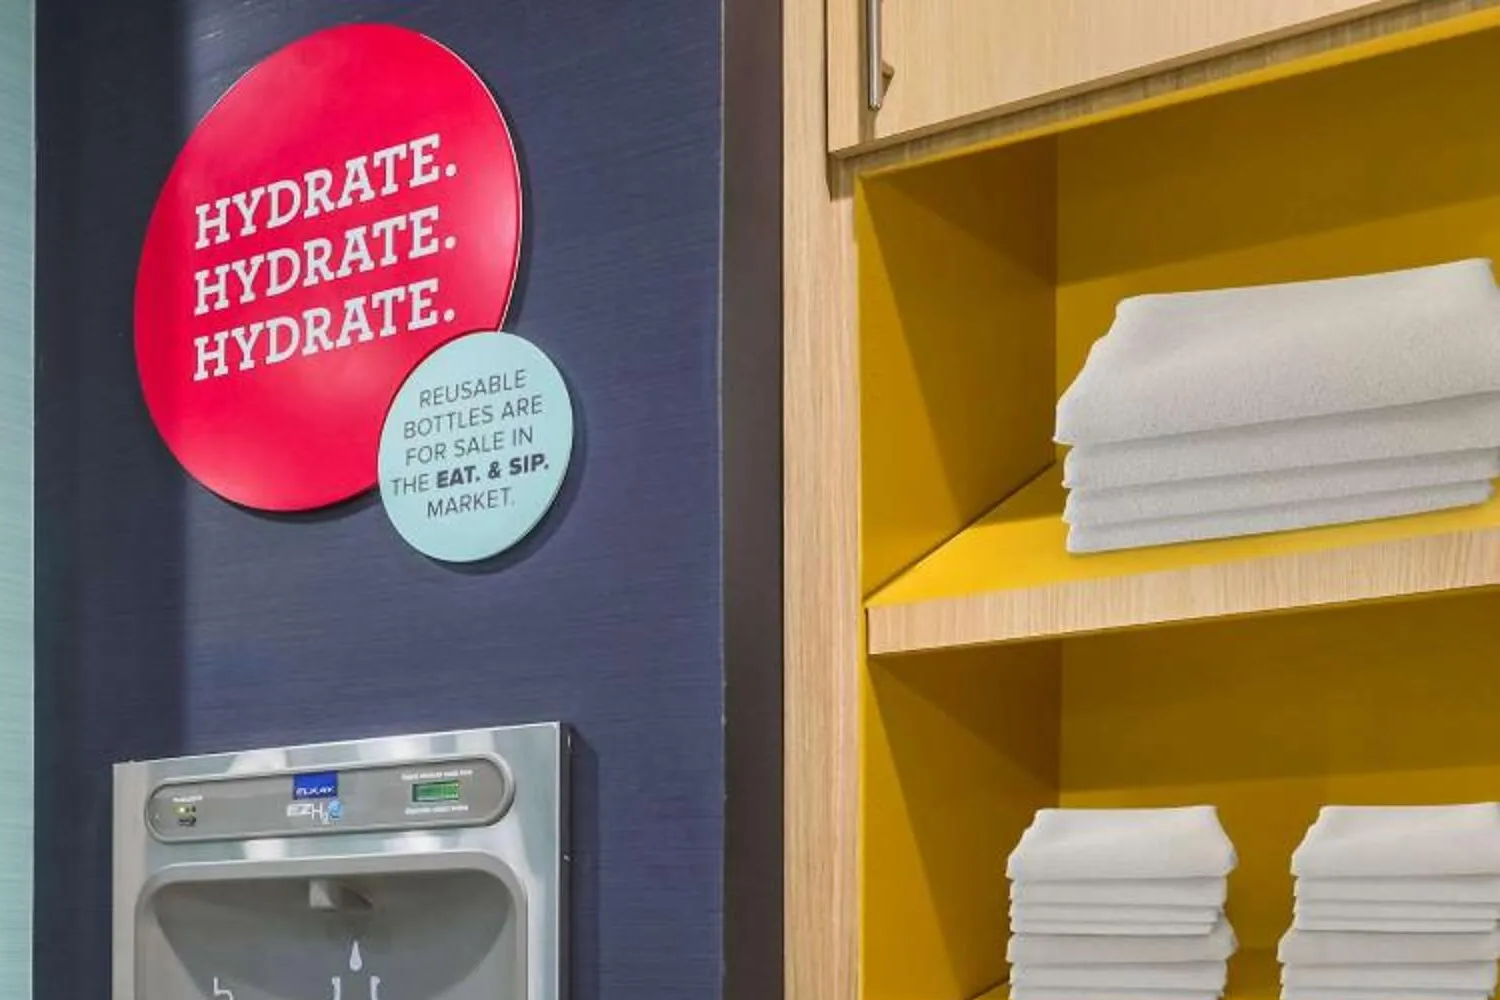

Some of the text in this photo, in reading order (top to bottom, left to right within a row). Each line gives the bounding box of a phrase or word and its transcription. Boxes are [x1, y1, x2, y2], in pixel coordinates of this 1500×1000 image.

[194, 133, 457, 249] HYDRATE.
[194, 205, 457, 315] HYDRATE.
[193, 278, 456, 381] HYDRATE.
[419, 369, 527, 408] REUSABLE
[403, 394, 543, 439] BOTTLES ARE
[405, 425, 533, 466] FOR SALE IN
[390, 453, 549, 496] THE EAT. & SIP.
[426, 487, 515, 519] MARKET.
